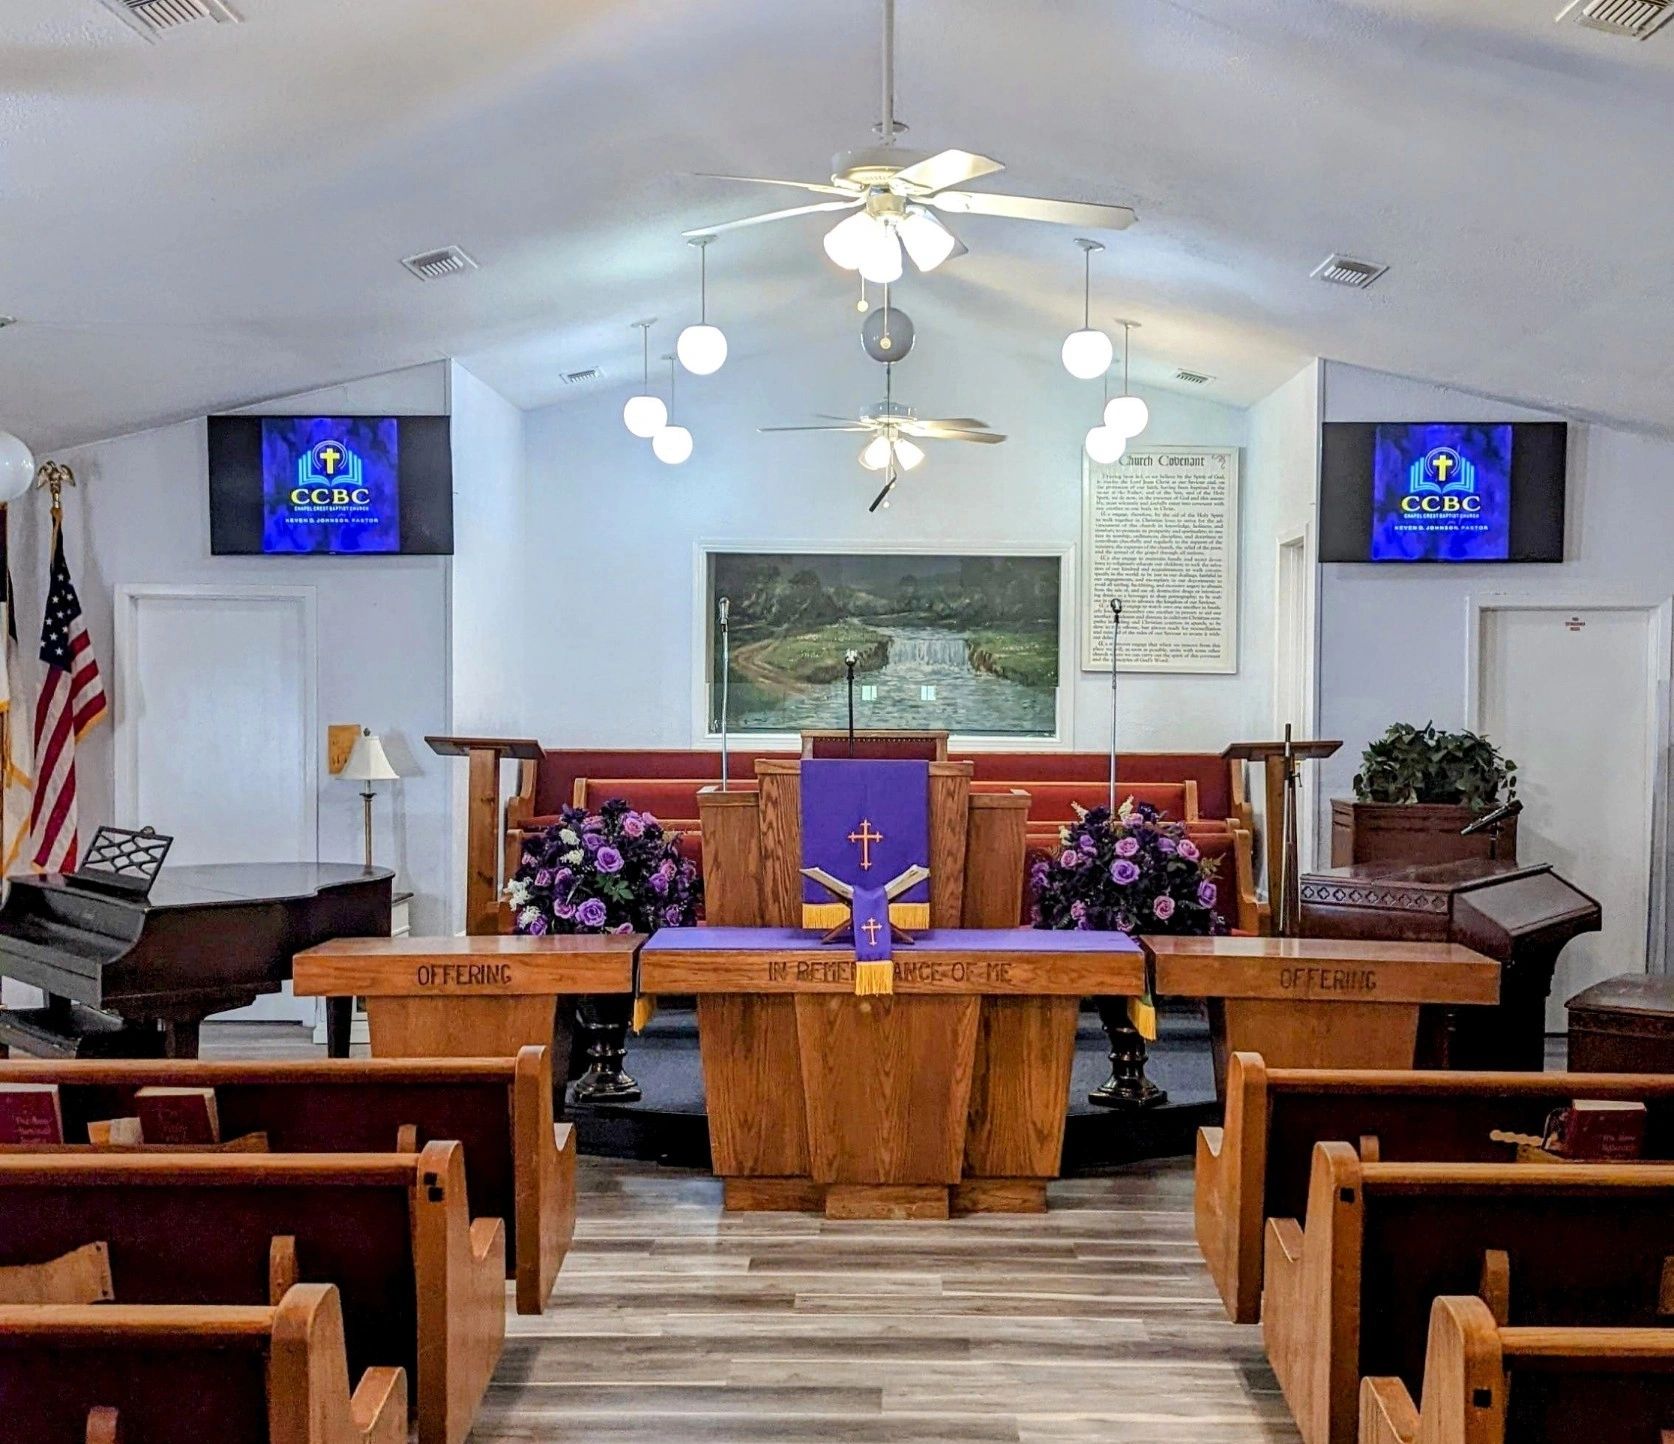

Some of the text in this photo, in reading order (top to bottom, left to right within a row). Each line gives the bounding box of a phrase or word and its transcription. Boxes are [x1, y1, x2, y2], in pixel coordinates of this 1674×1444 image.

[1119, 456, 1205, 467] Church Covenant
[291, 488, 370, 504] CCBC
[1402, 496, 1481, 512] CCBC
[418, 964, 512, 985] OFFERING
[768, 961, 1012, 984] IN REMEANCE OF ME
[1280, 968, 1376, 990] OFFERING
